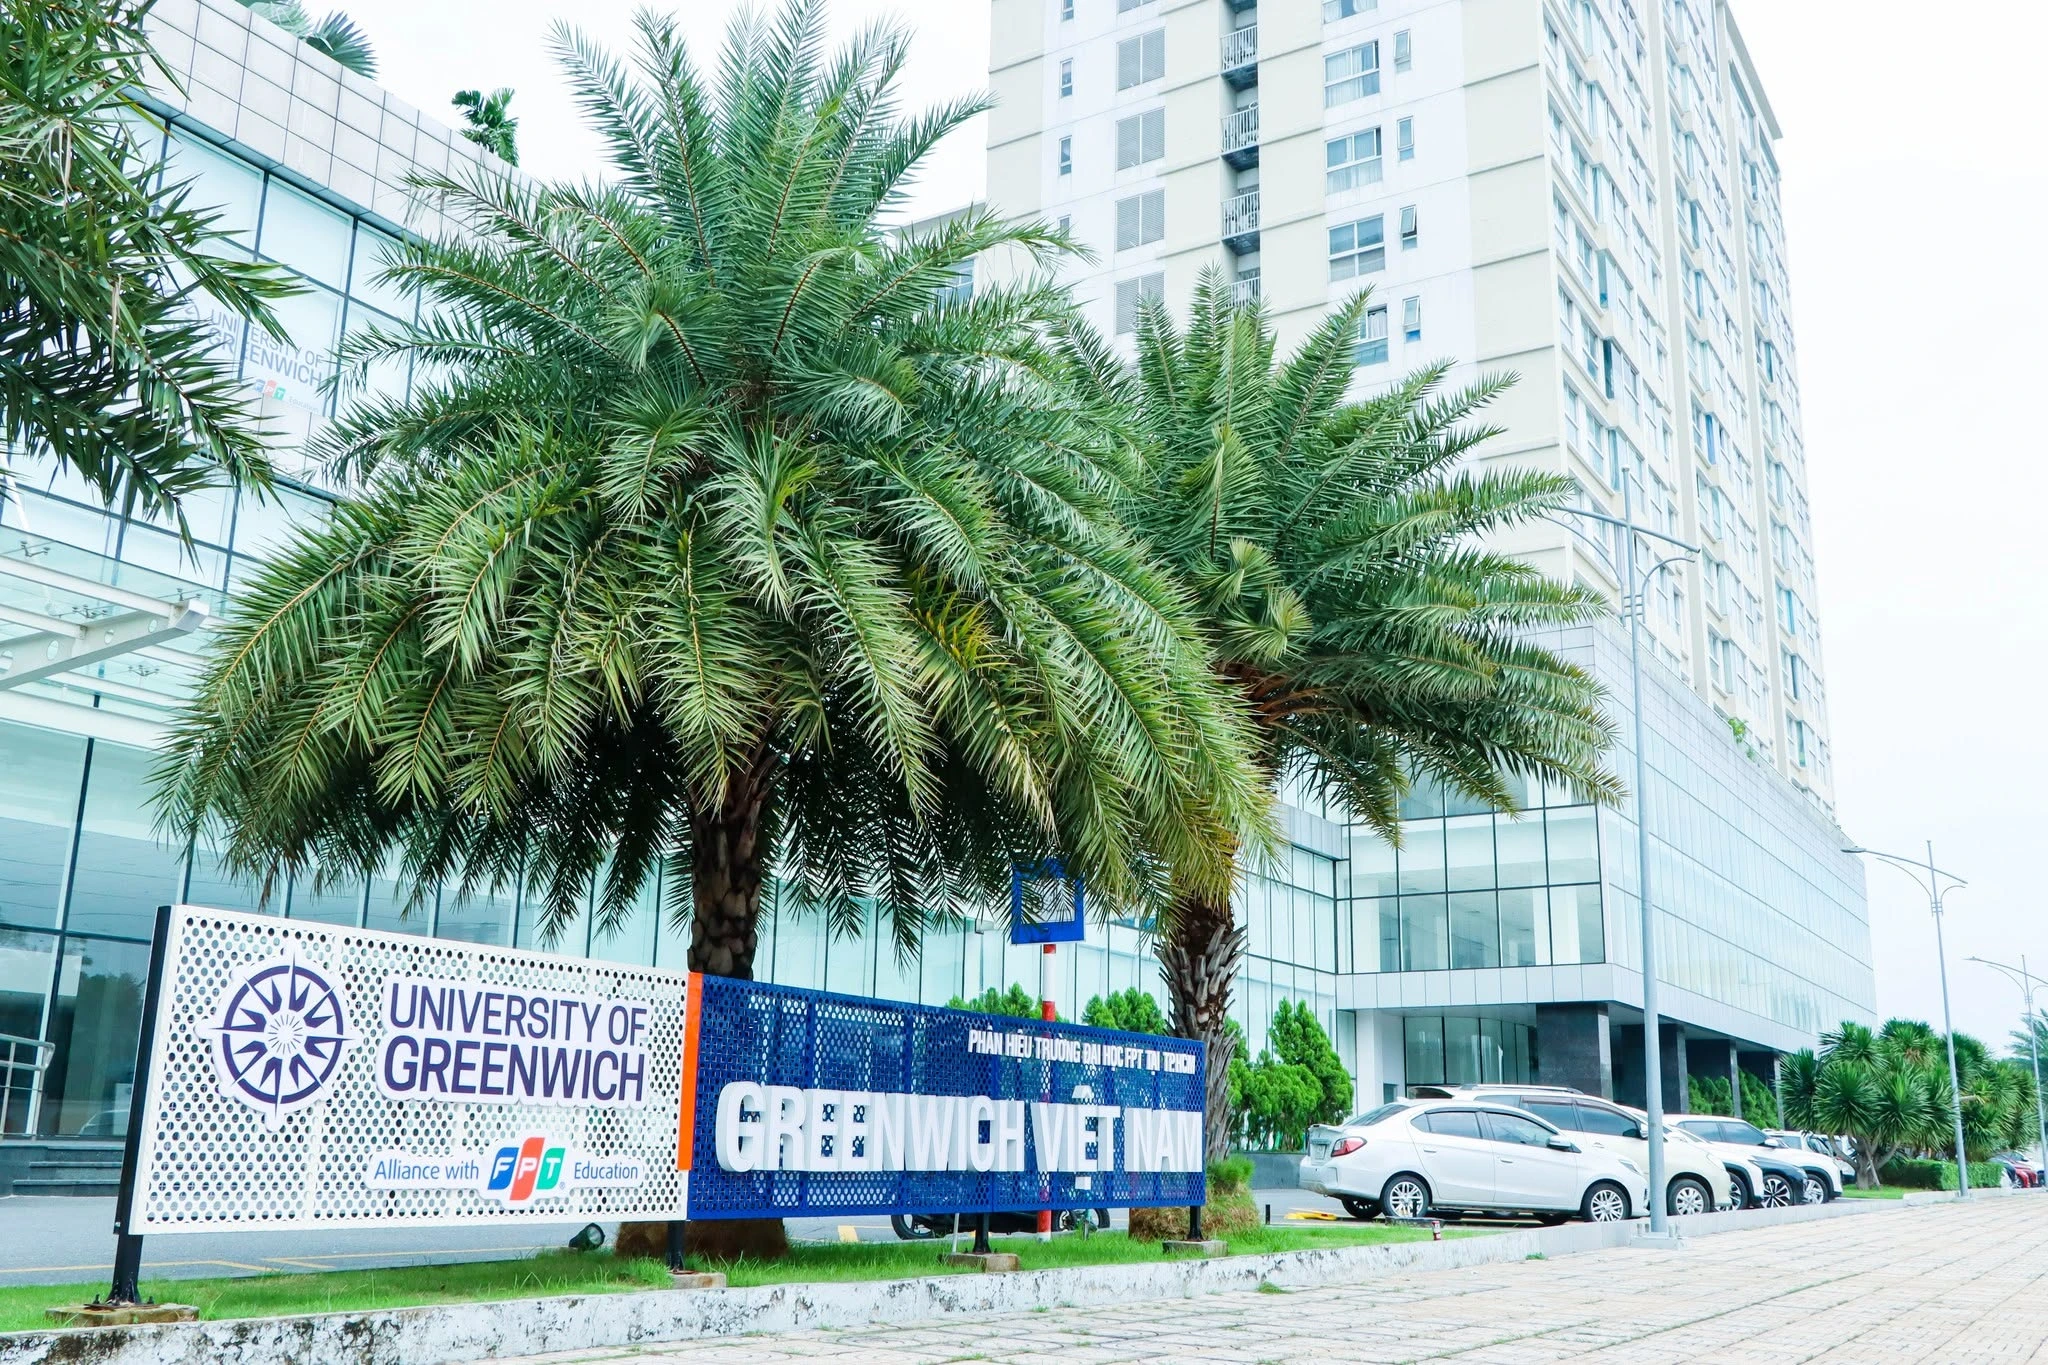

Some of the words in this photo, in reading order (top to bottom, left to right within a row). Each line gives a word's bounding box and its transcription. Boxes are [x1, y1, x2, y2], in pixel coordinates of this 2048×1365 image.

[208, 327, 323, 387] GRENWICH
[210, 308, 302, 360] UNIERSITY
[305, 350, 324, 367] OF
[389, 982, 602, 1043] UNIVERSITY
[608, 1005, 648, 1046] OF
[383, 1034, 646, 1102] GREENWICH
[967, 1023, 1003, 1056] PHÂN
[1005, 1028, 1033, 1063] HIỆU
[1034, 1033, 1081, 1063] TRƯỜNG
[1102, 1044, 1124, 1071] HỌC
[1124, 1047, 1144, 1070] FPT
[1145, 1049, 1161, 1076] TẠI
[715, 1081, 1025, 1173] GREENWICH
[1030, 1085, 1121, 1190] VIỆT
[1123, 1106, 1203, 1173] NAM
[373, 1159, 440, 1181] Alliance
[445, 1160, 480, 1181] with
[574, 1161, 639, 1180] Education
